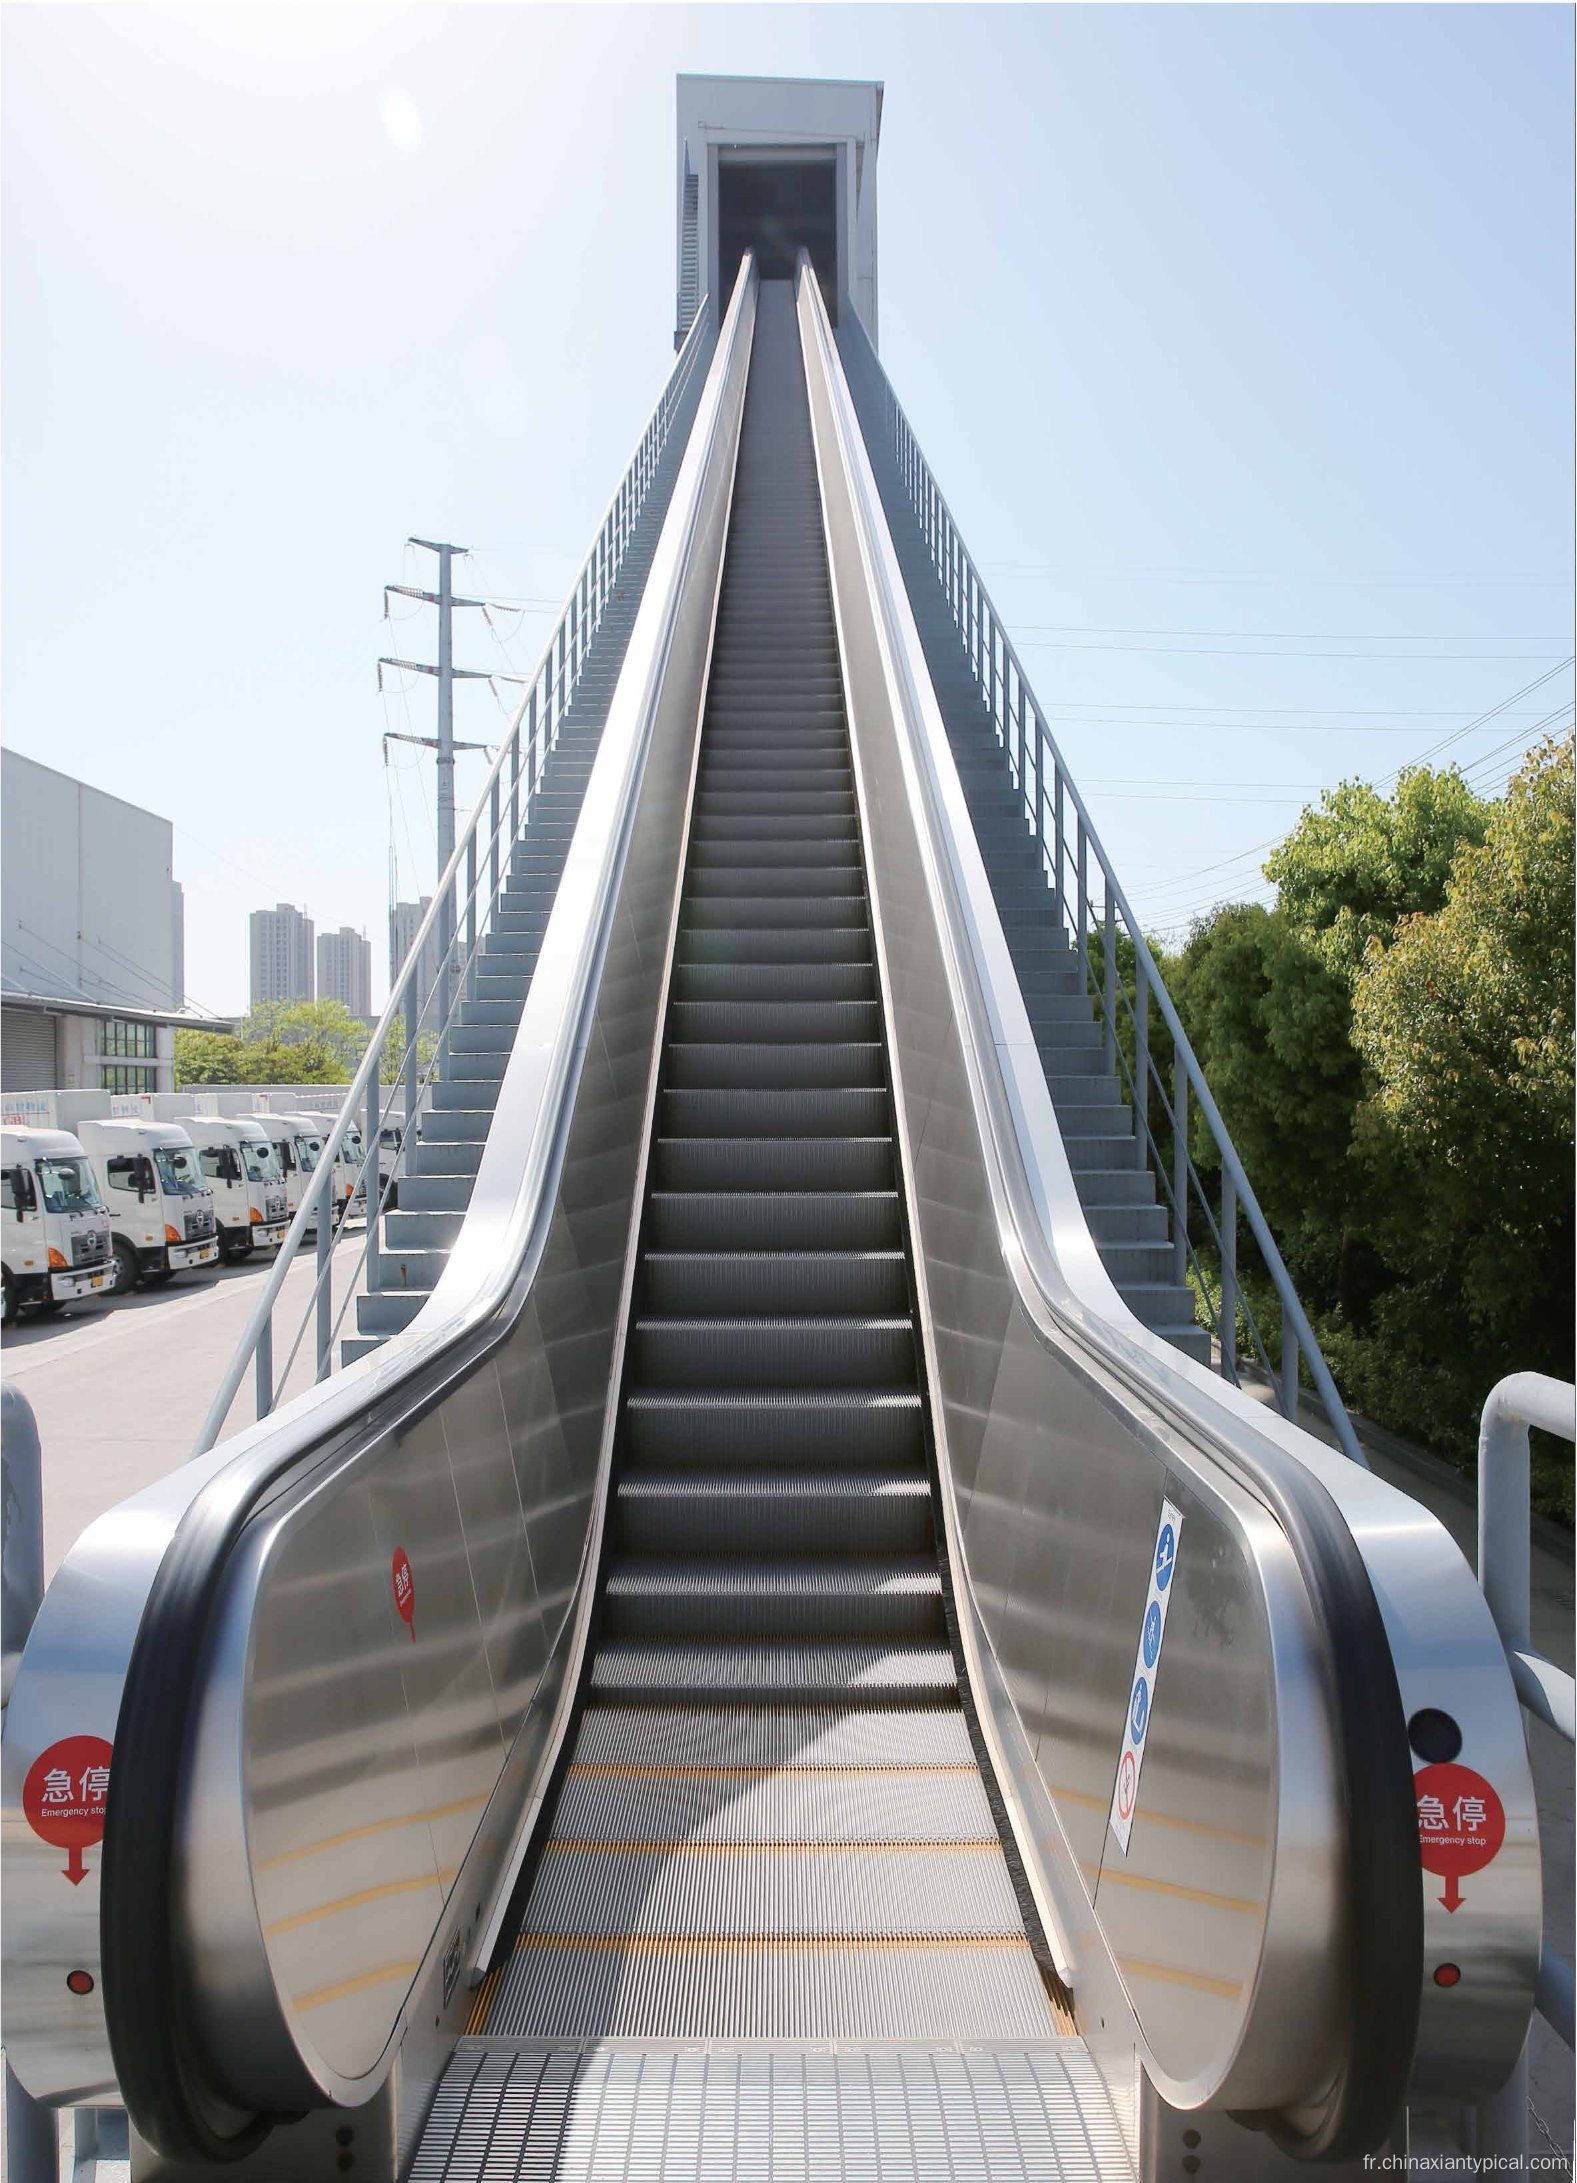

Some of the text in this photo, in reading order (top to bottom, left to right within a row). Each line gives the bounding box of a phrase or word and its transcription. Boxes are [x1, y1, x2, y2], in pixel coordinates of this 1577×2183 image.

[41, 1766, 110, 1802] 急停
[41, 1806, 106, 1817] Emergency sto
[1417, 1795, 1486, 1831] 急停
[1467, 1837, 1486, 1846] stop
